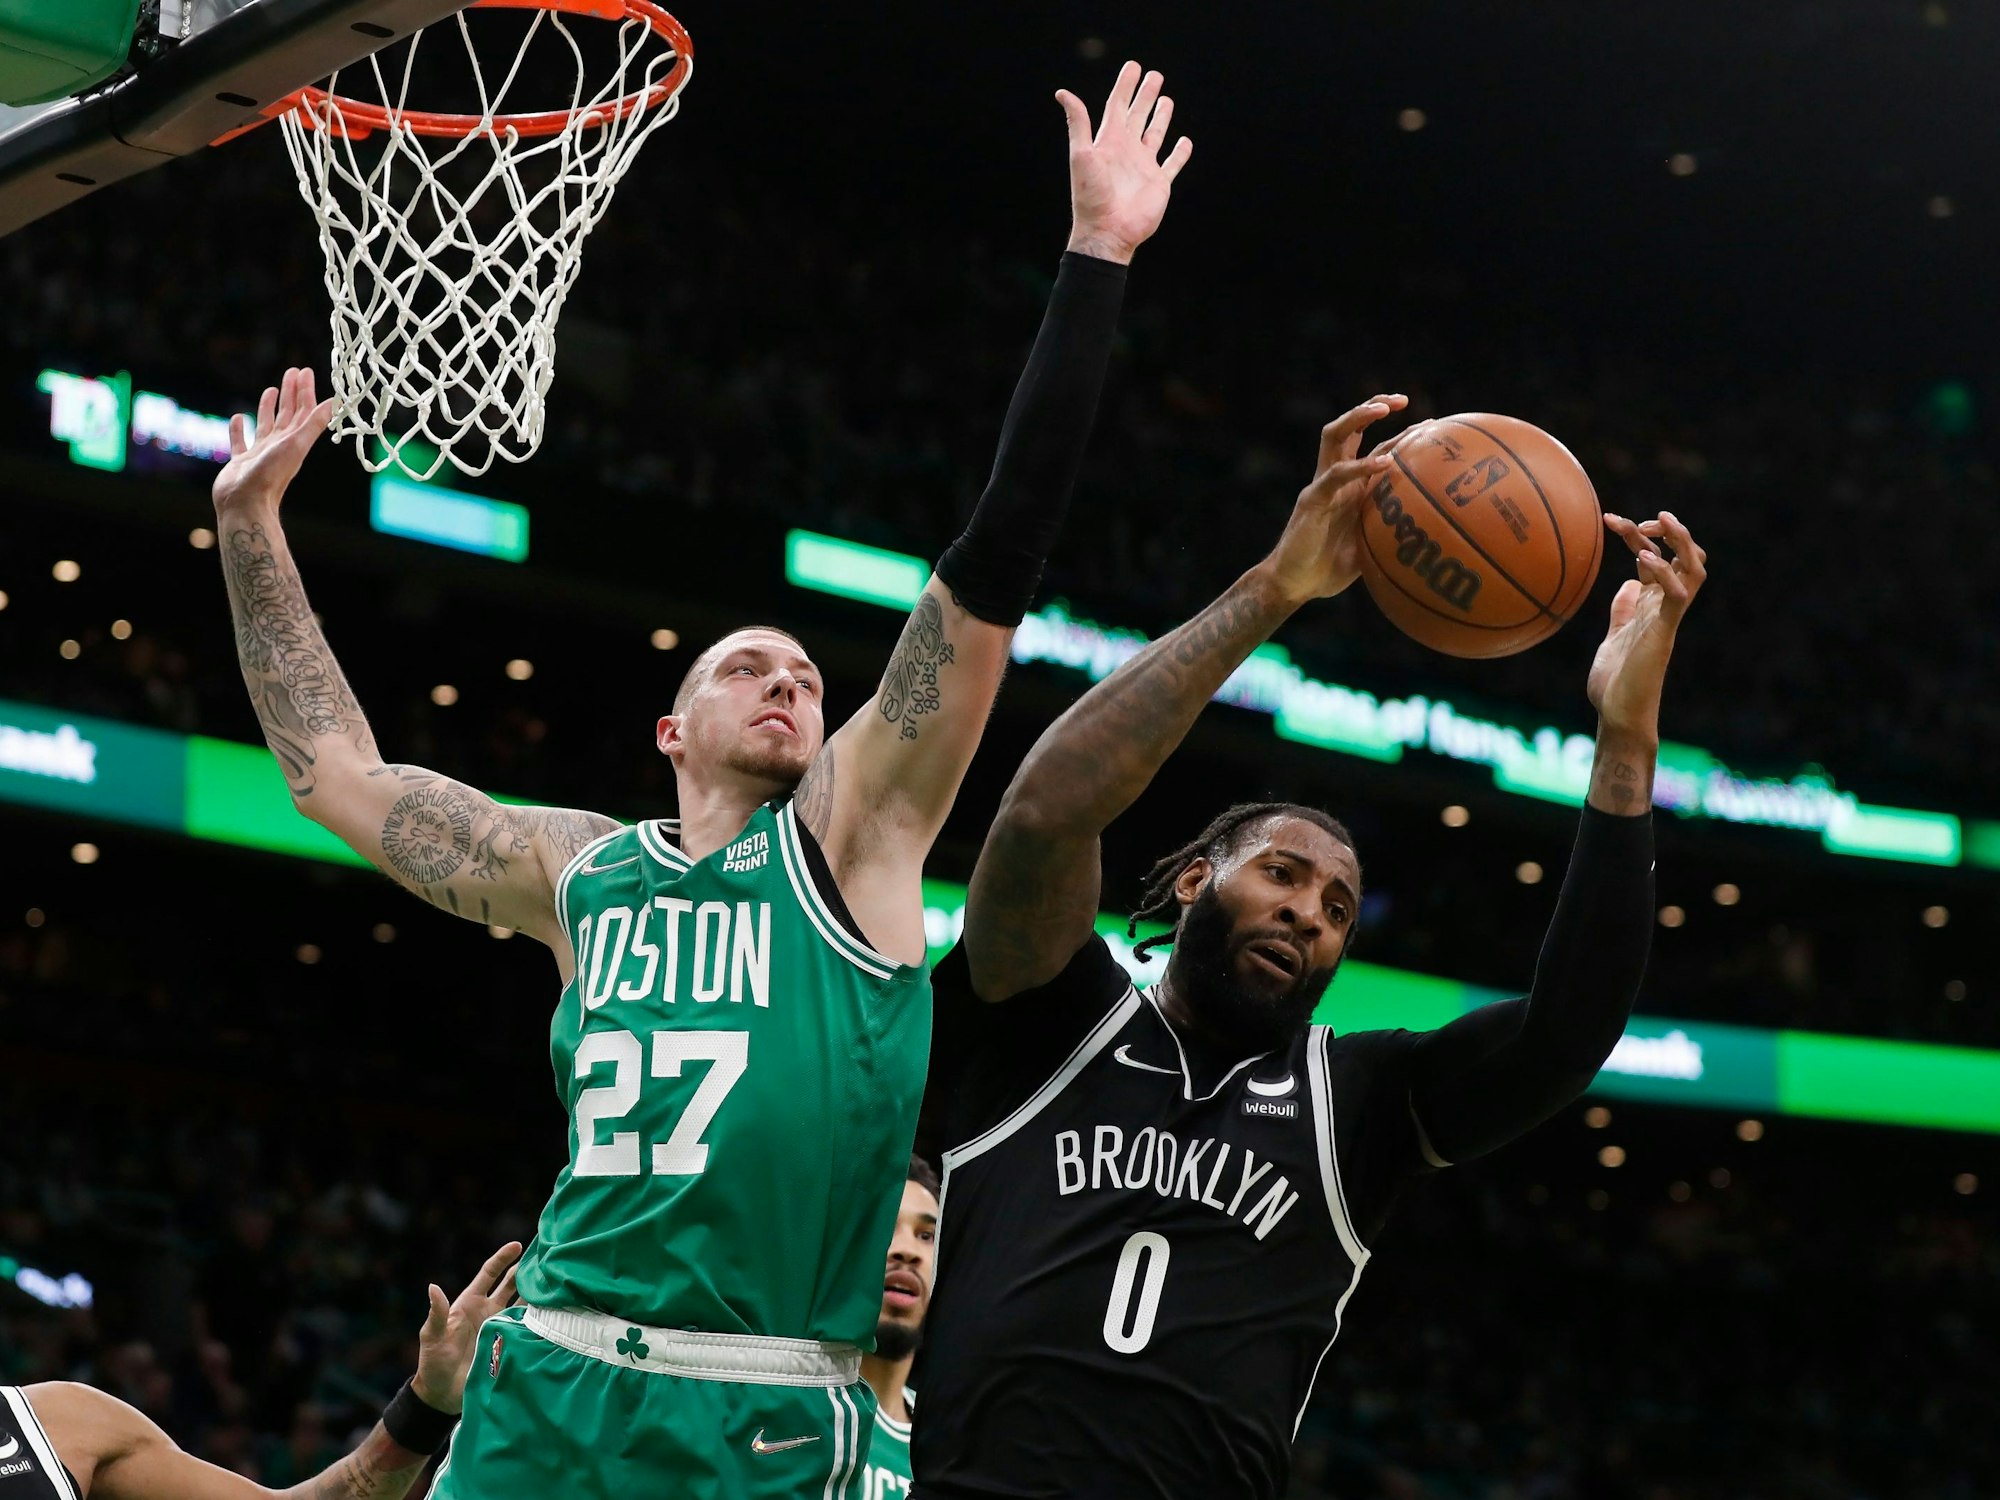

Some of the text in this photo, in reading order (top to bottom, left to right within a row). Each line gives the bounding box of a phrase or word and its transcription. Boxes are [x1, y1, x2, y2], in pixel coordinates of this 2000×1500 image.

[1371, 472, 1483, 612] Wilson
[722, 849, 769, 872] PRINT
[726, 831, 769, 861] VISTA
[577, 896, 771, 1032] BOSTON
[572, 1030, 749, 1176] 27
[1245, 1102, 1294, 1117] Webull
[1055, 1125, 1299, 1241] BROOKLYN
[1103, 1231, 1170, 1354] 0
[0, 1460, 31, 1476] ebull
